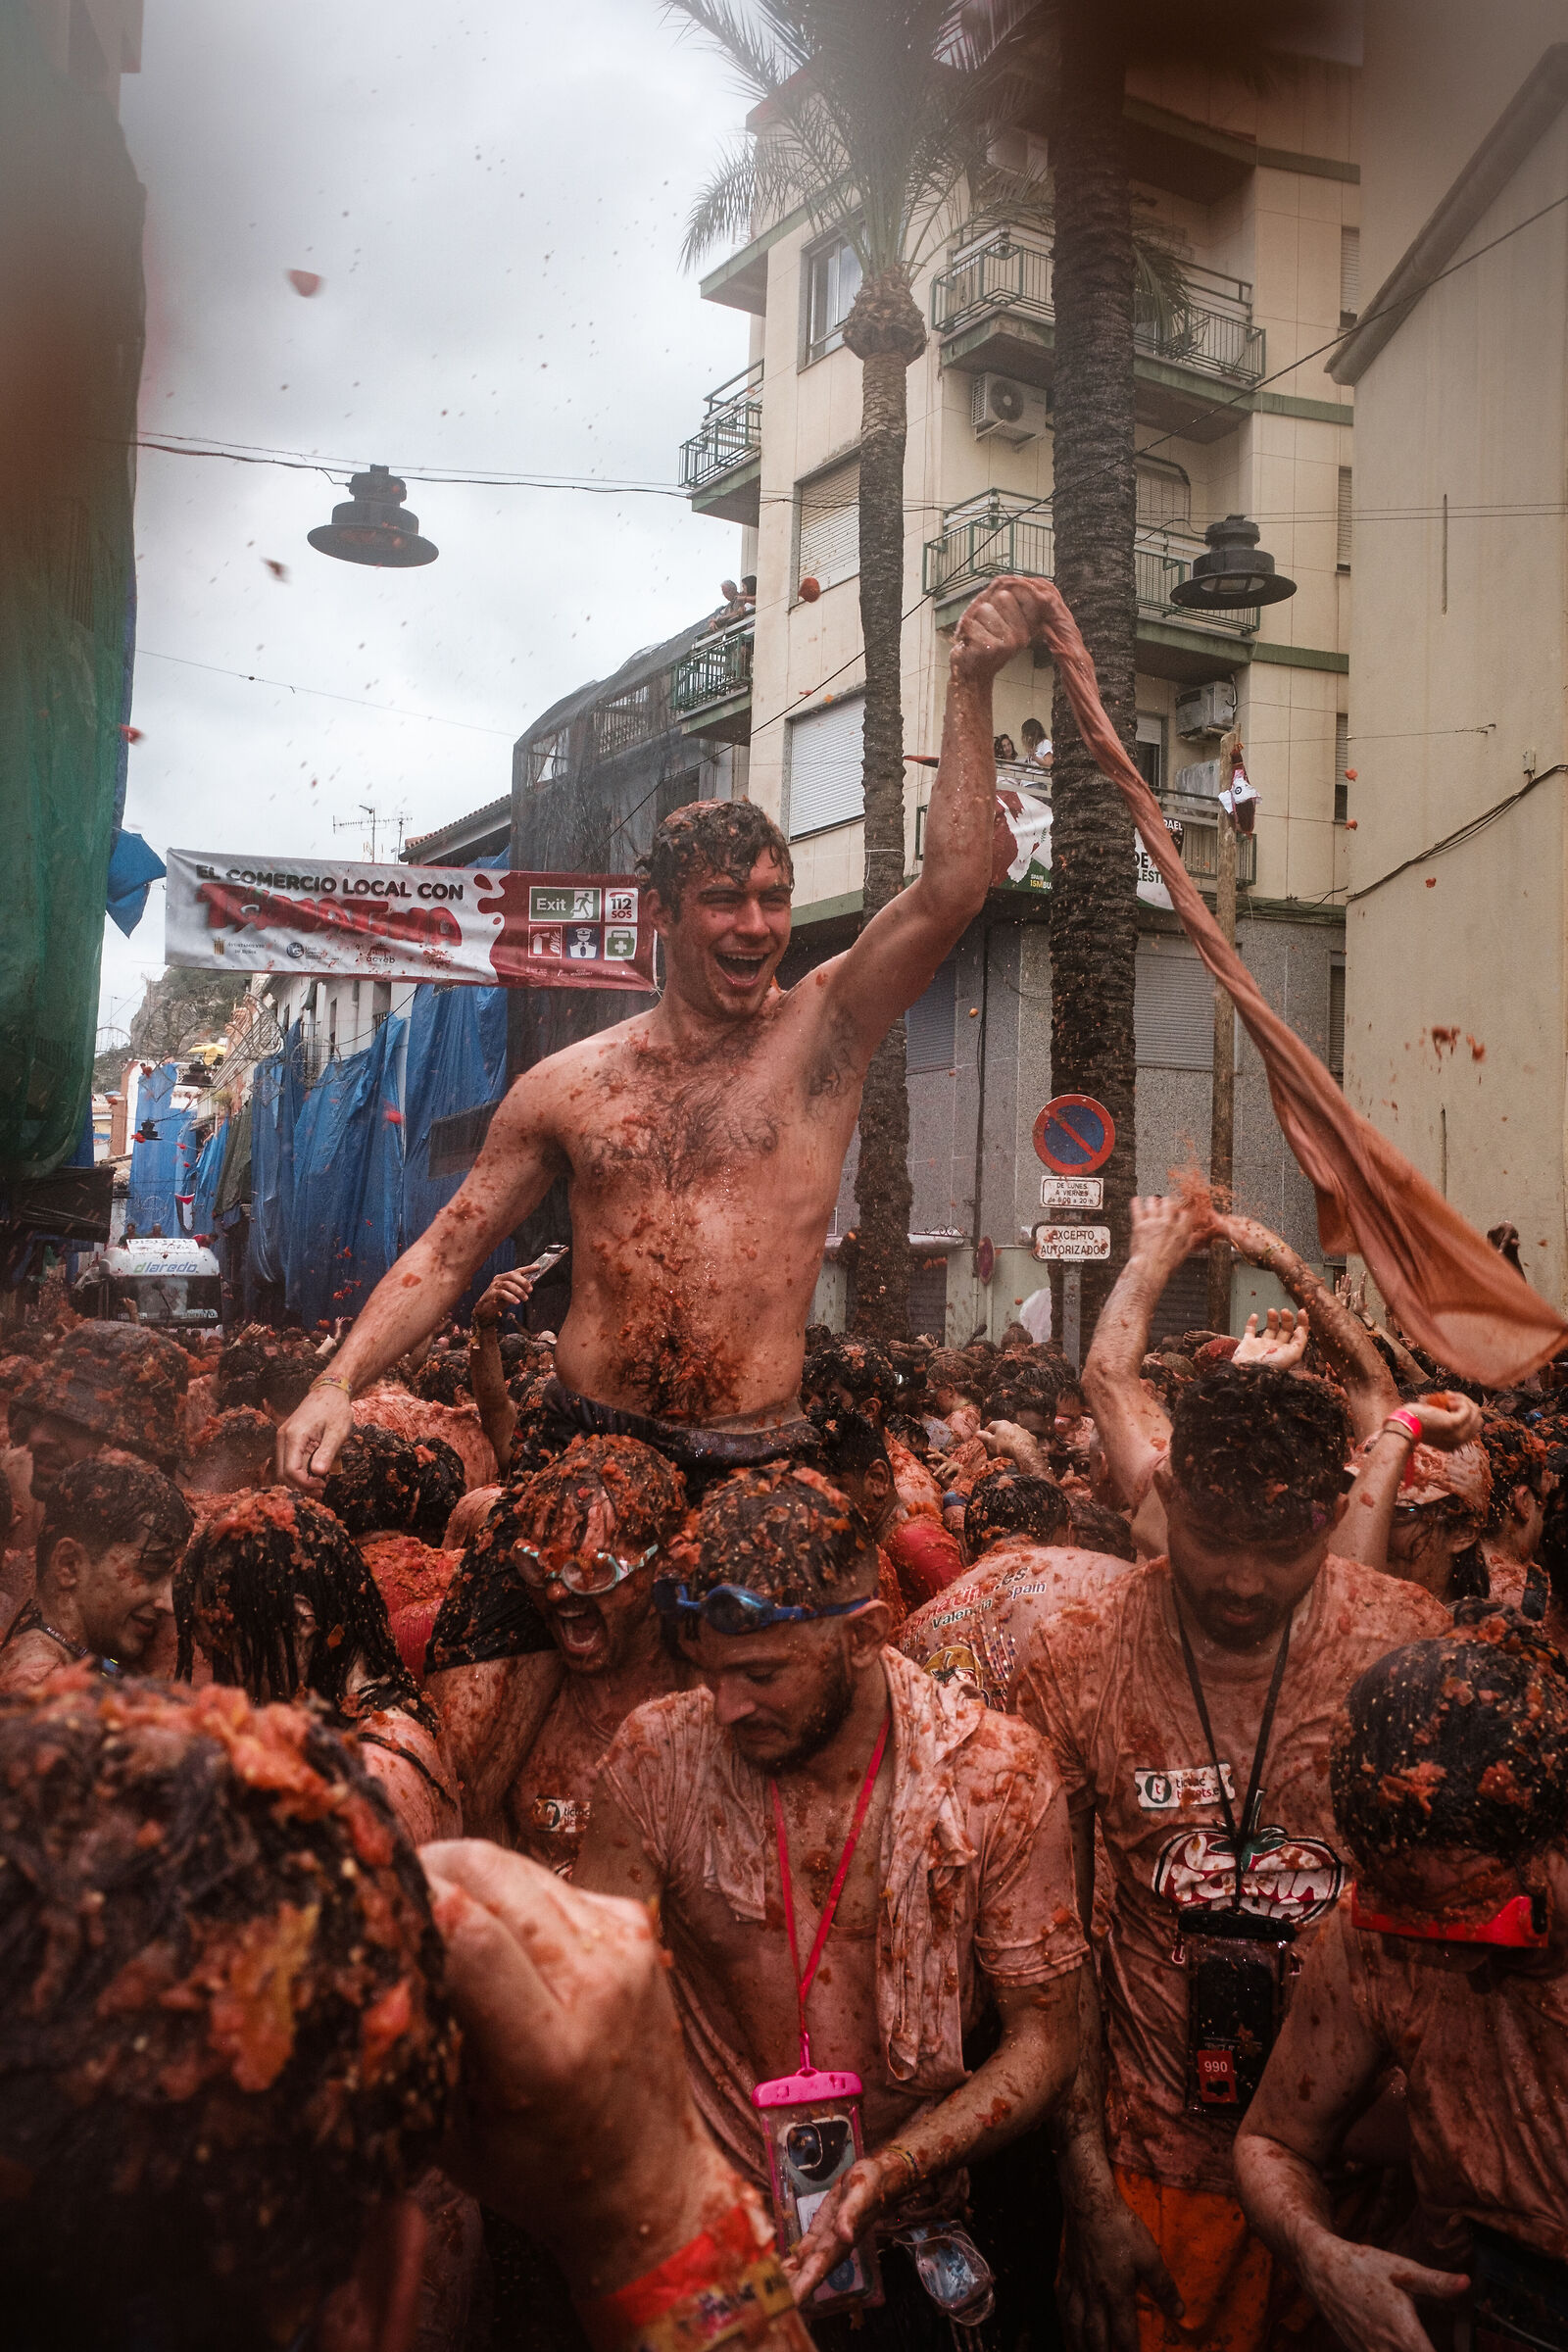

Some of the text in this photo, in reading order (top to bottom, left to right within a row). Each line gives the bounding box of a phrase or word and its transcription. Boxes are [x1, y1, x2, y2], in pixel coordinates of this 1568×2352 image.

[1163, 819, 1183, 831] RAEL
[196, 863, 464, 901] EL COMERCIO LOCAL CON
[536, 897, 566, 911] Exit
[611, 898, 632, 909] 112
[611, 909, 632, 919] SOS
[1053, 1230, 1095, 1241] EXCEPTO
[1041, 1245, 1106, 1255] AUTORIZADOS
[1005, 1582, 1047, 1600] Spain
[1203, 2061, 1228, 2073] 990
